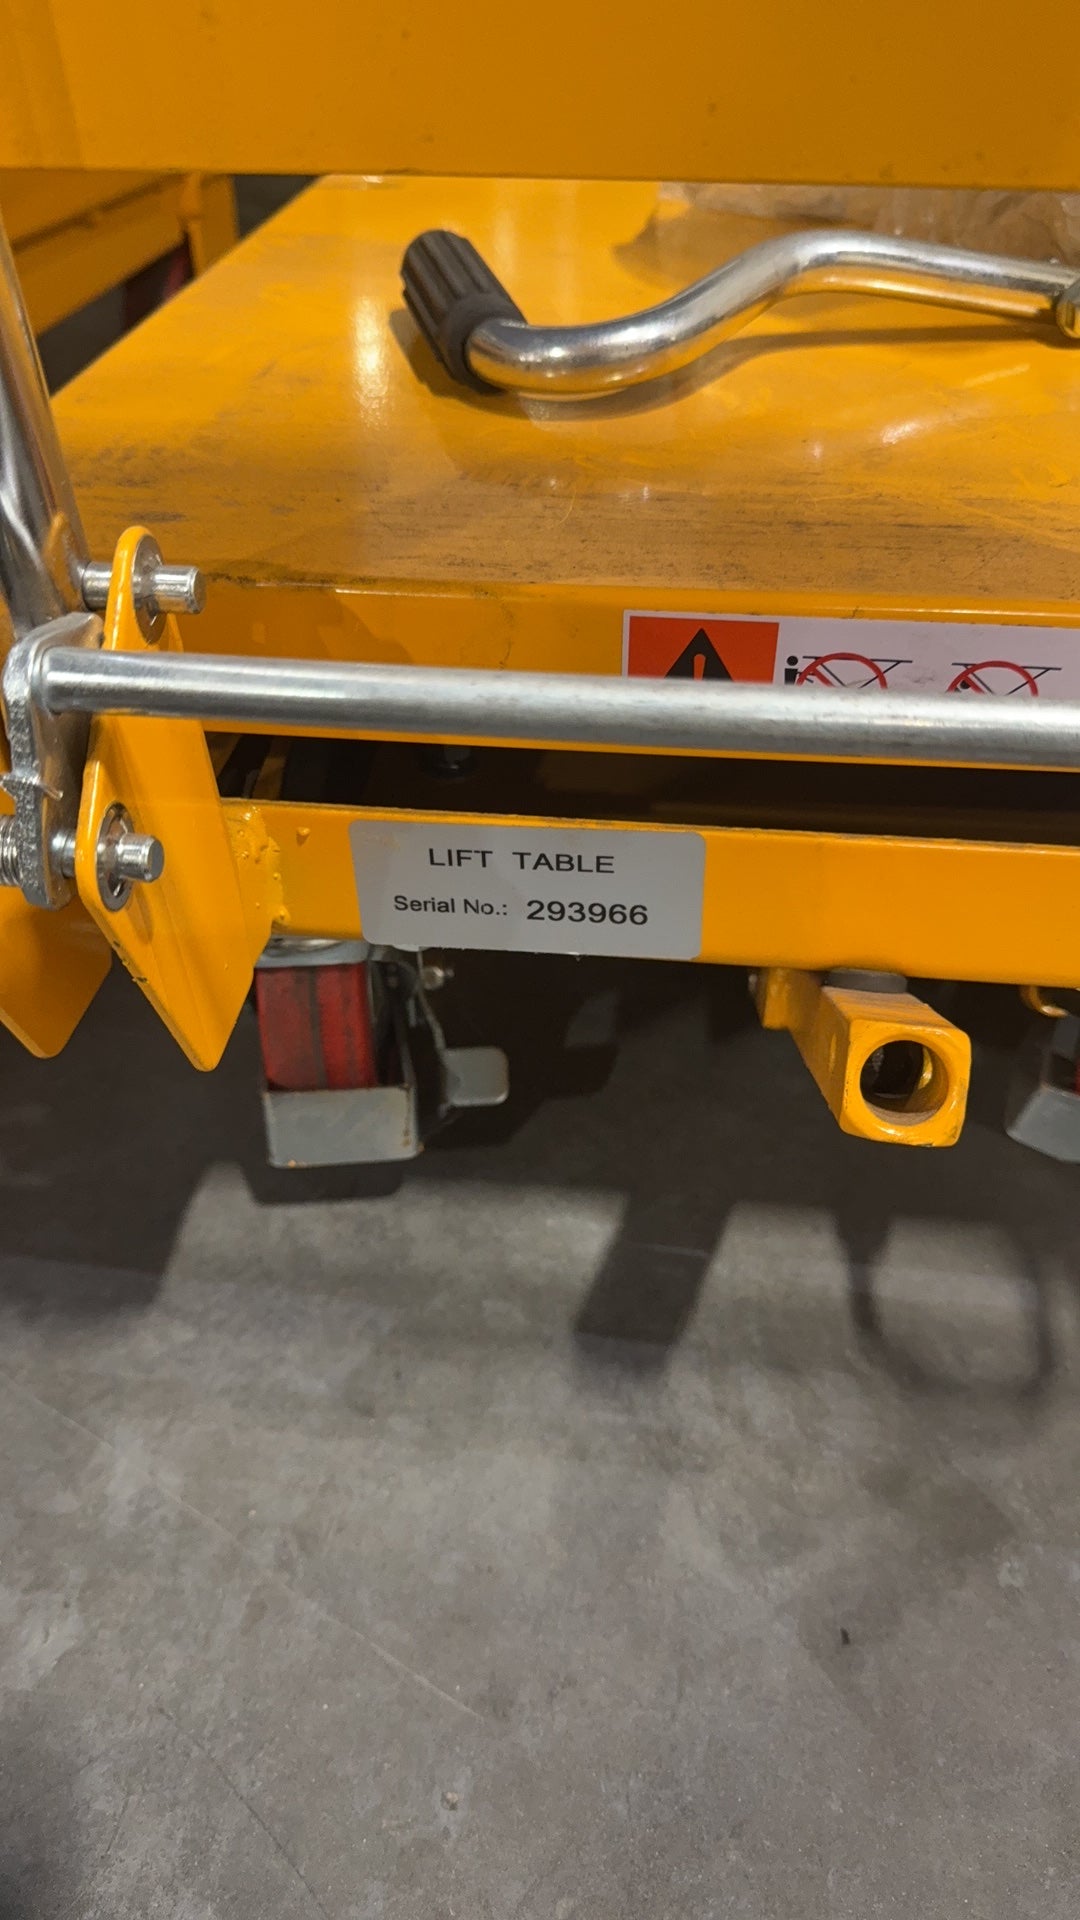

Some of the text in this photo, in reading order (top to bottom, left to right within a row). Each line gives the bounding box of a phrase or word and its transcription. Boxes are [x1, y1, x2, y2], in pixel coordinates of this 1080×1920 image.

[428, 847, 615, 874] LIFT TABLE
[393, 895, 648, 926] Serial No.: 293966
